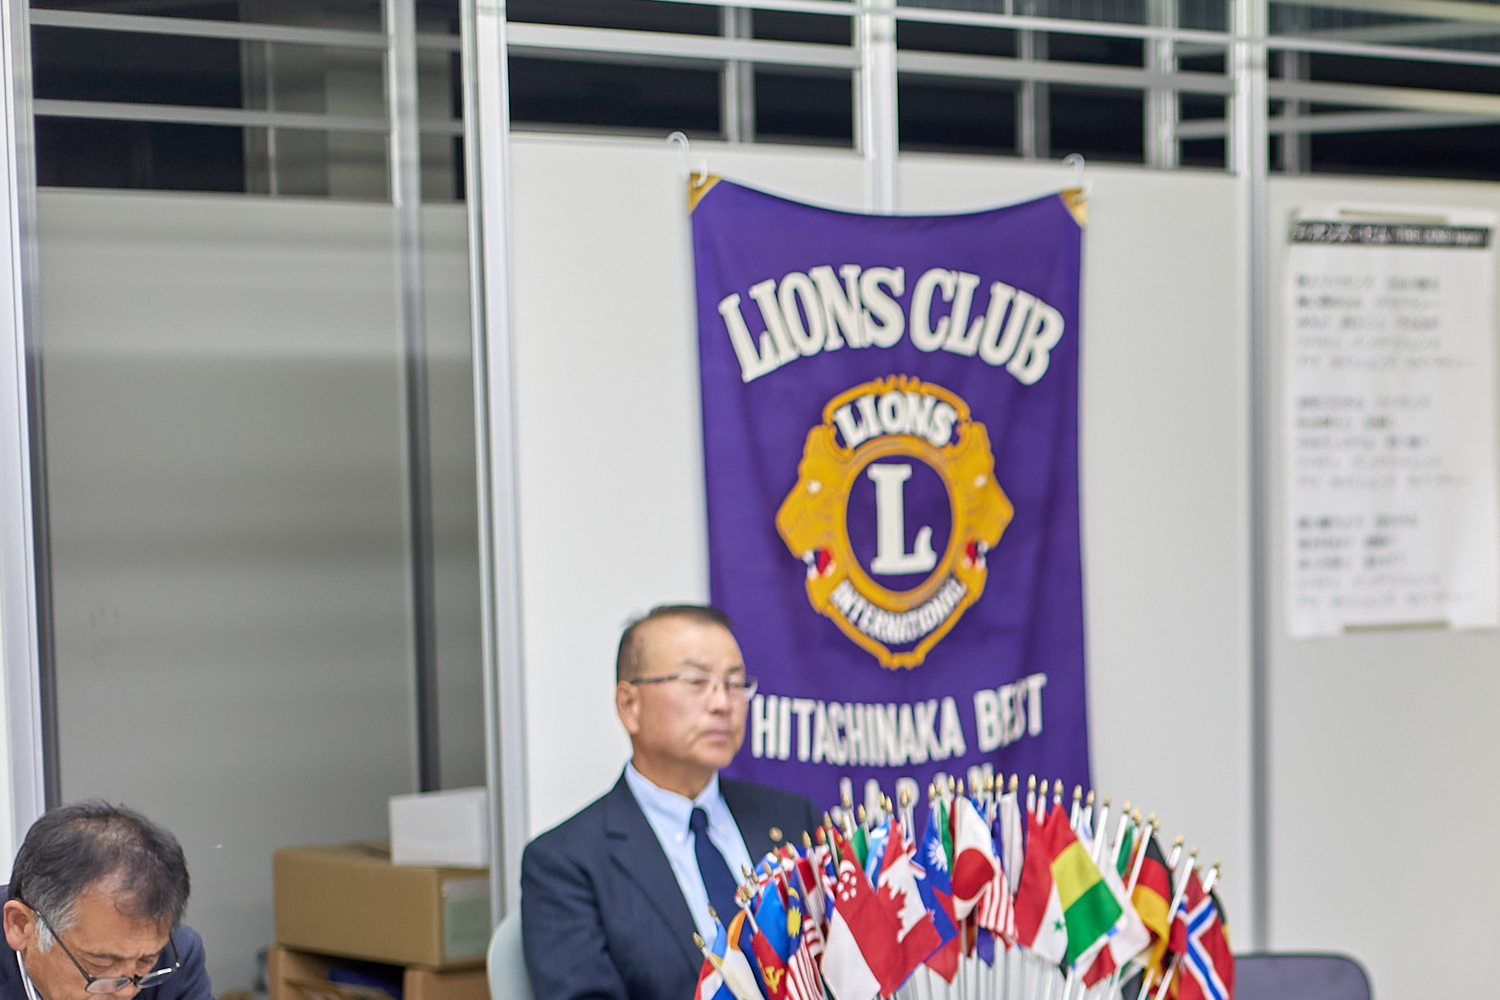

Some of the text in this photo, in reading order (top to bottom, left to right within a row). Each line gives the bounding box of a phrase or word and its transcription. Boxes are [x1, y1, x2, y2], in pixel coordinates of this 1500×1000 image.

[717, 264, 1066, 386] LIONS CLUB
[833, 389, 958, 449] LIONS
[866, 463, 937, 575] L
[829, 577, 968, 645] INTERNATIONAL
[750, 672, 1048, 768] HITACHINAKA BEST
